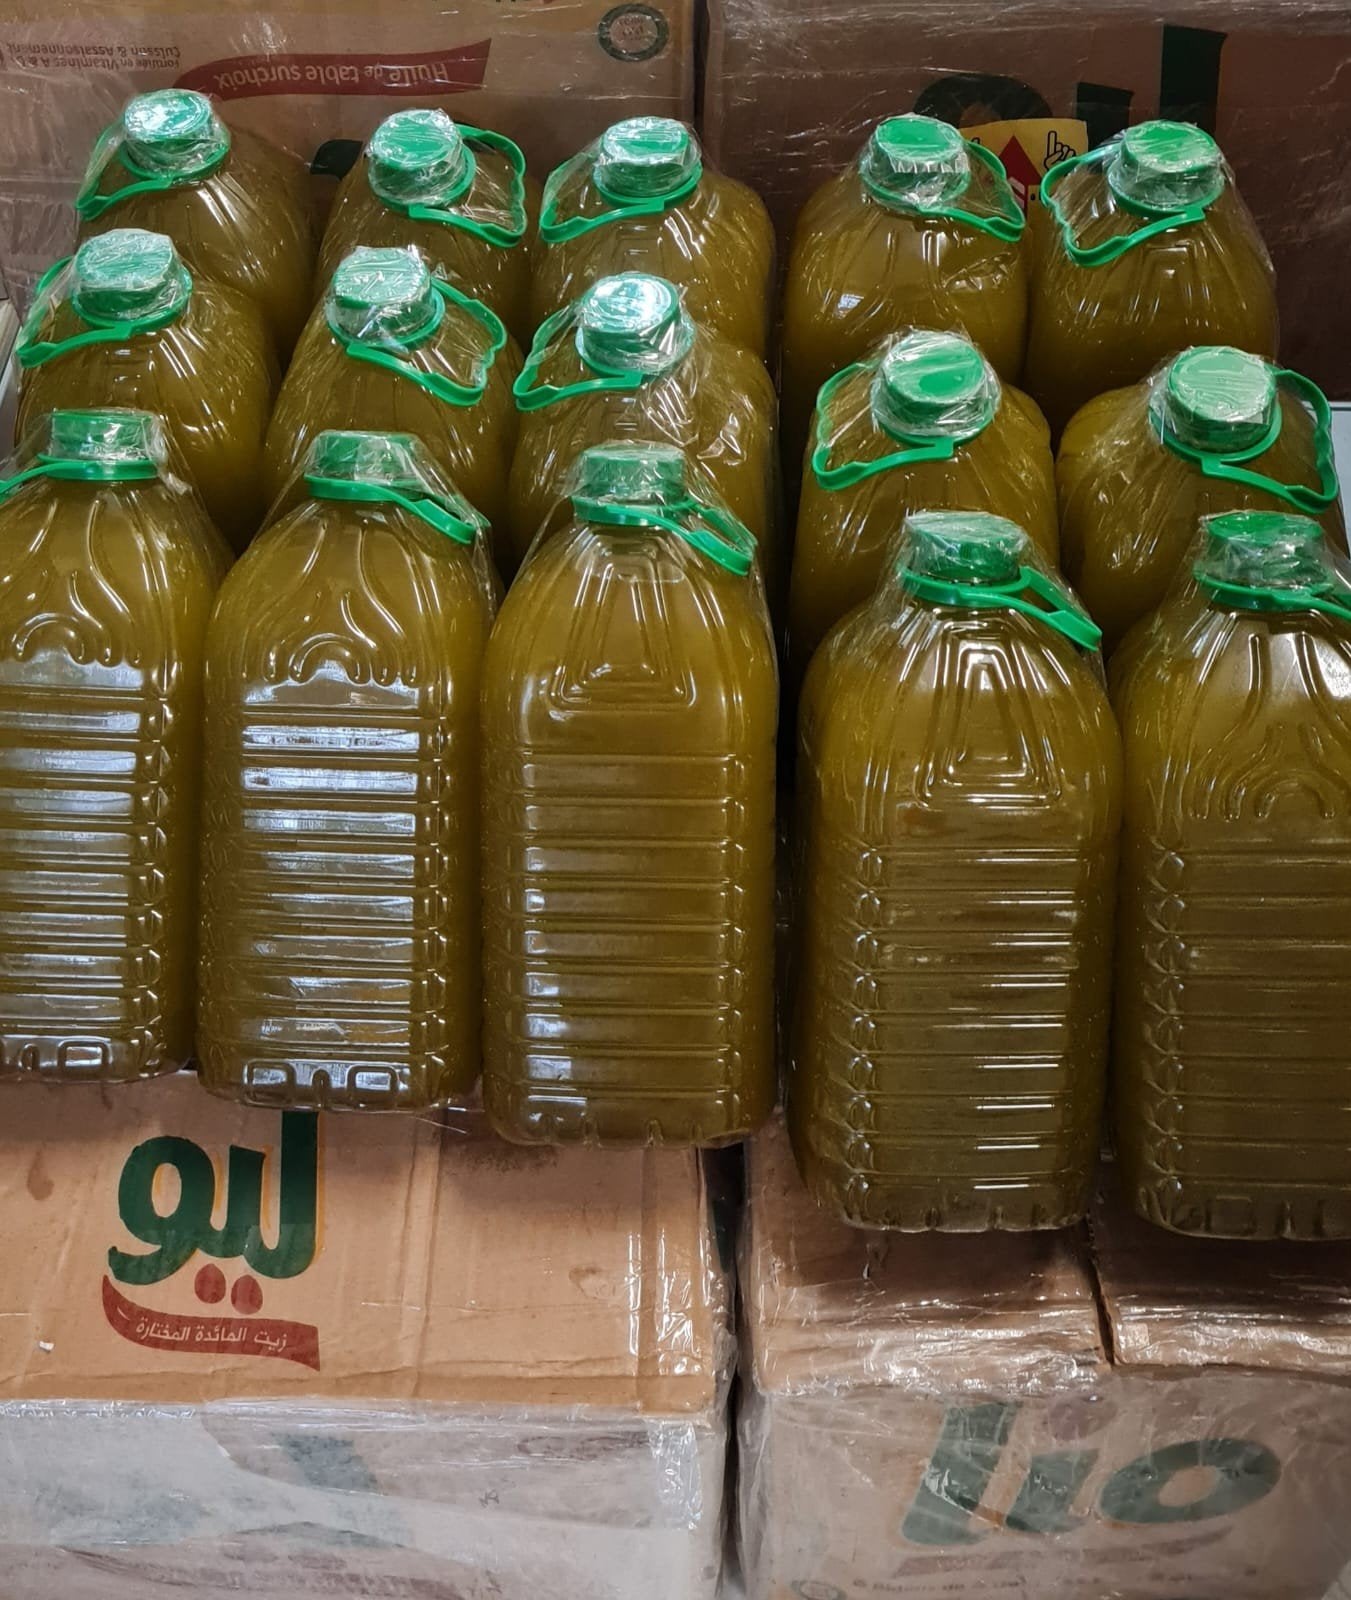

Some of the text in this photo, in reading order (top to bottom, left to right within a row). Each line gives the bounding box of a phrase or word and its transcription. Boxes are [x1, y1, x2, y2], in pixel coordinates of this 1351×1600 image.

[55, 56, 119, 71] Vitamines
[130, 46, 181, 59] Cuisson
[214, 62, 448, 91] Huile de table surchoix
[108, 1110, 320, 1315] ليو
[136, 1316, 288, 1353] زيت المائدة المختارة
